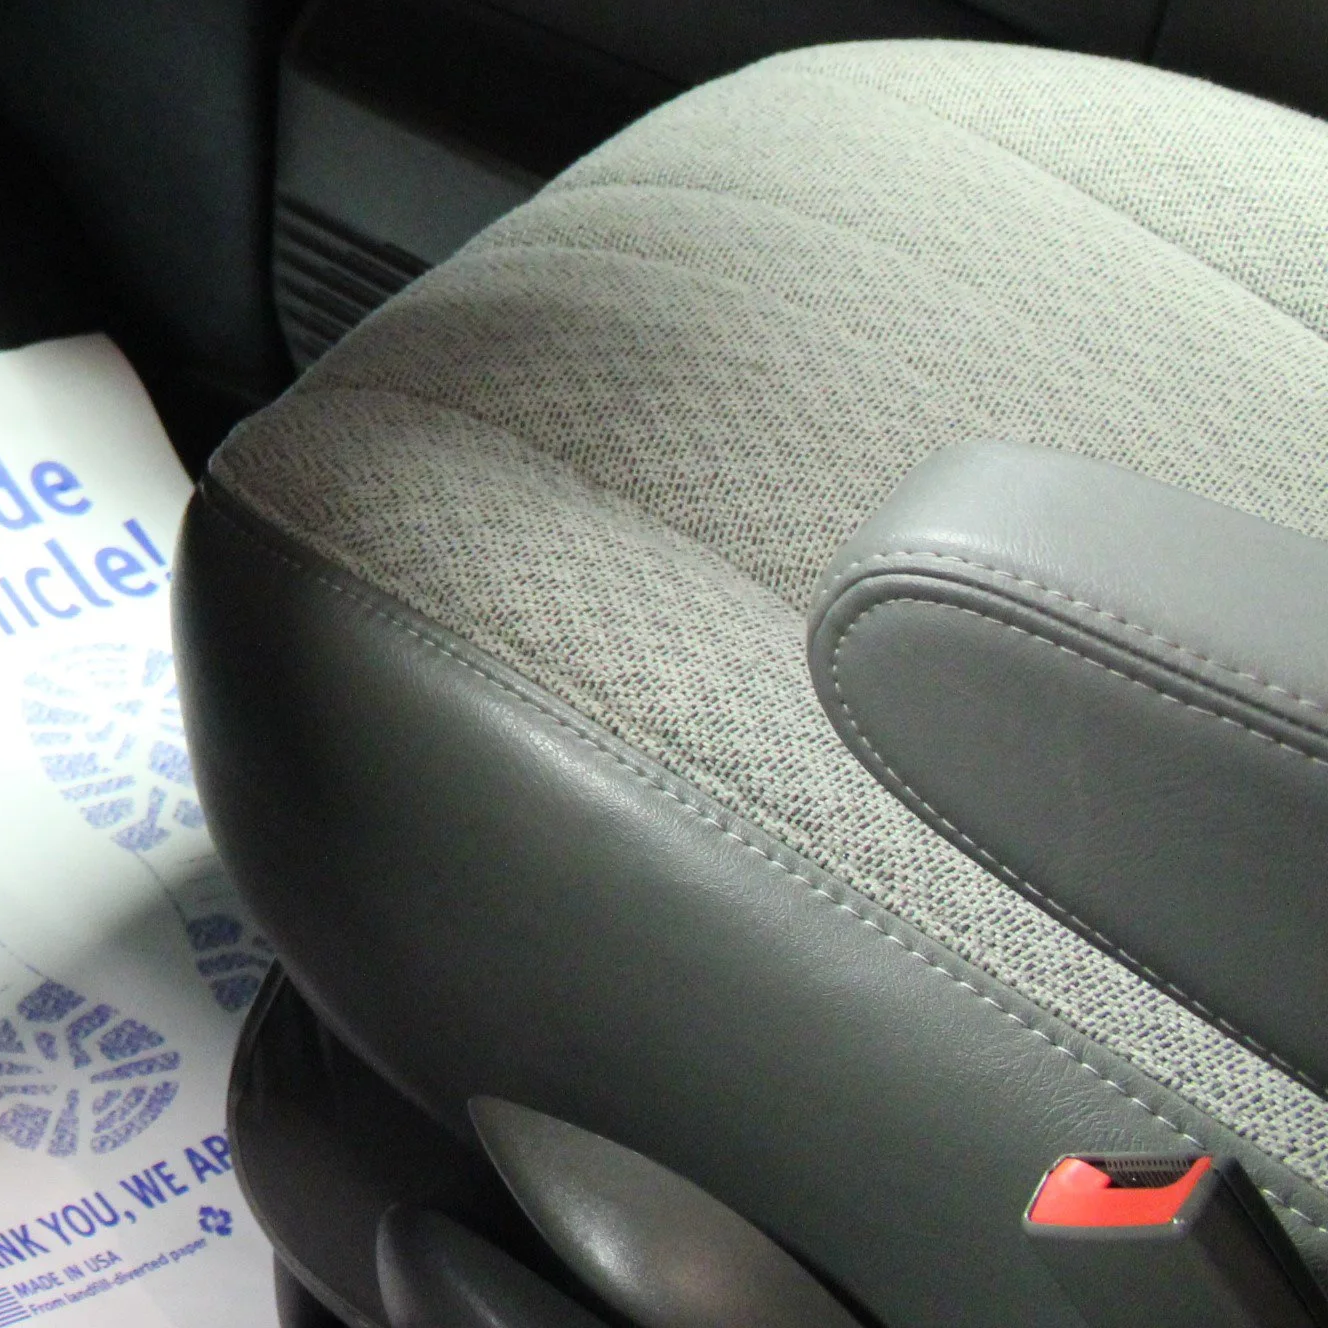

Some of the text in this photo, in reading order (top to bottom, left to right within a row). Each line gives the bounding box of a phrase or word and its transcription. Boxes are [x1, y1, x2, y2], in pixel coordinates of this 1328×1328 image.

[37, 1191, 138, 1246] YOU,
[119, 1160, 190, 1210] WE
[12, 1250, 123, 1298] MADE IN USA
[29, 1297, 66, 1315] From
[169, 1238, 207, 1262] paper
